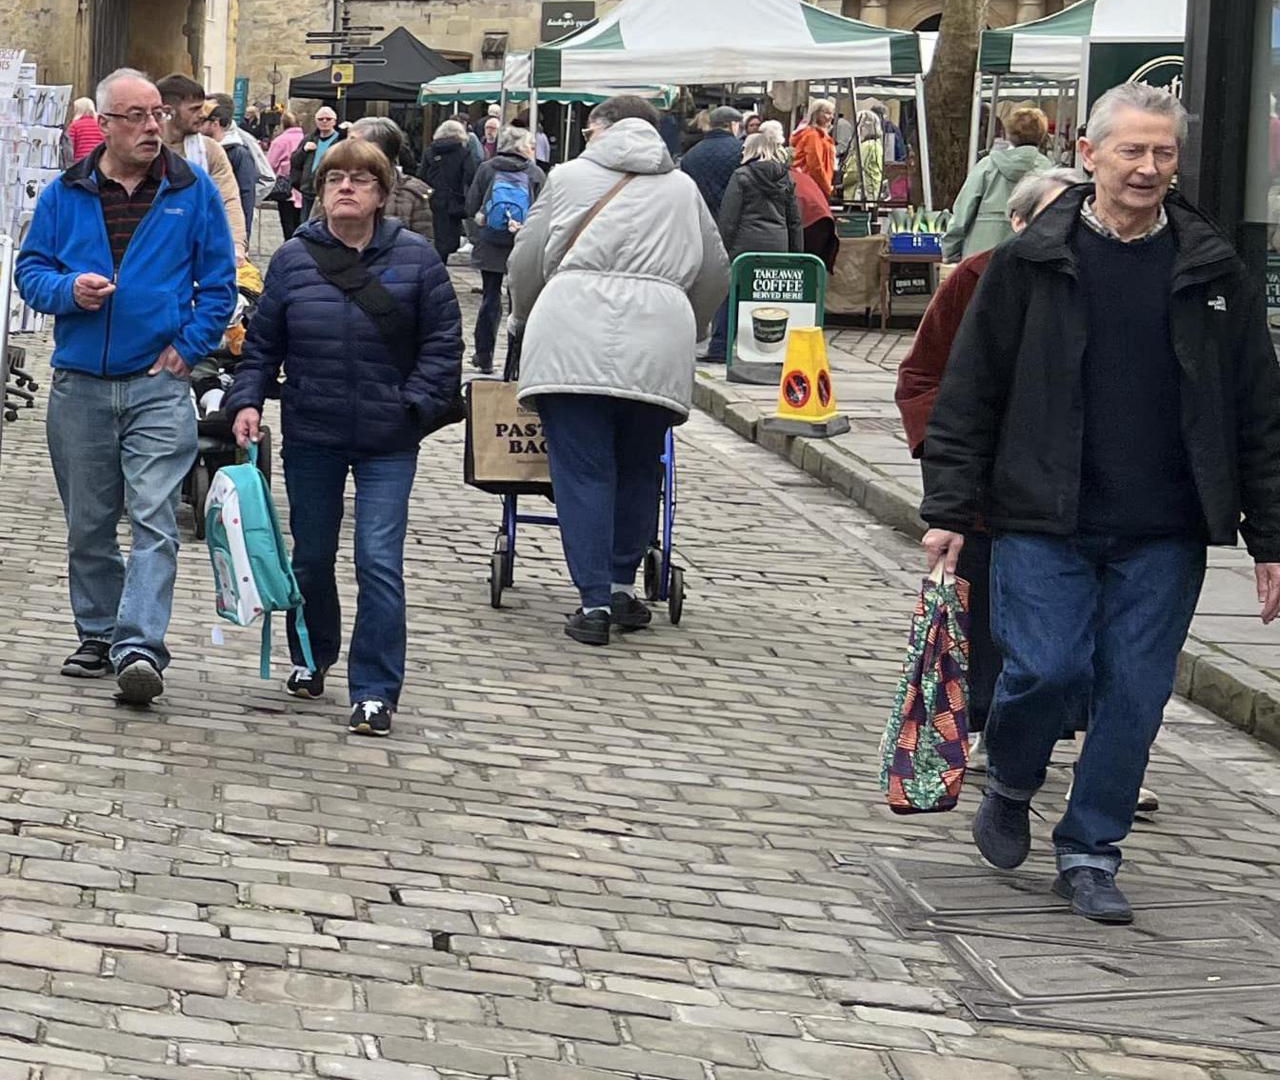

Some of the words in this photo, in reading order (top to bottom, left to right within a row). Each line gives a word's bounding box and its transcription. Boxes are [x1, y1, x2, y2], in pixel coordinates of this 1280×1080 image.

[753, 268, 803, 279] TAKEAWAY
[753, 279, 803, 292] COFFEE
[753, 291, 781, 300] SERVED
[782, 291, 803, 300] HERE
